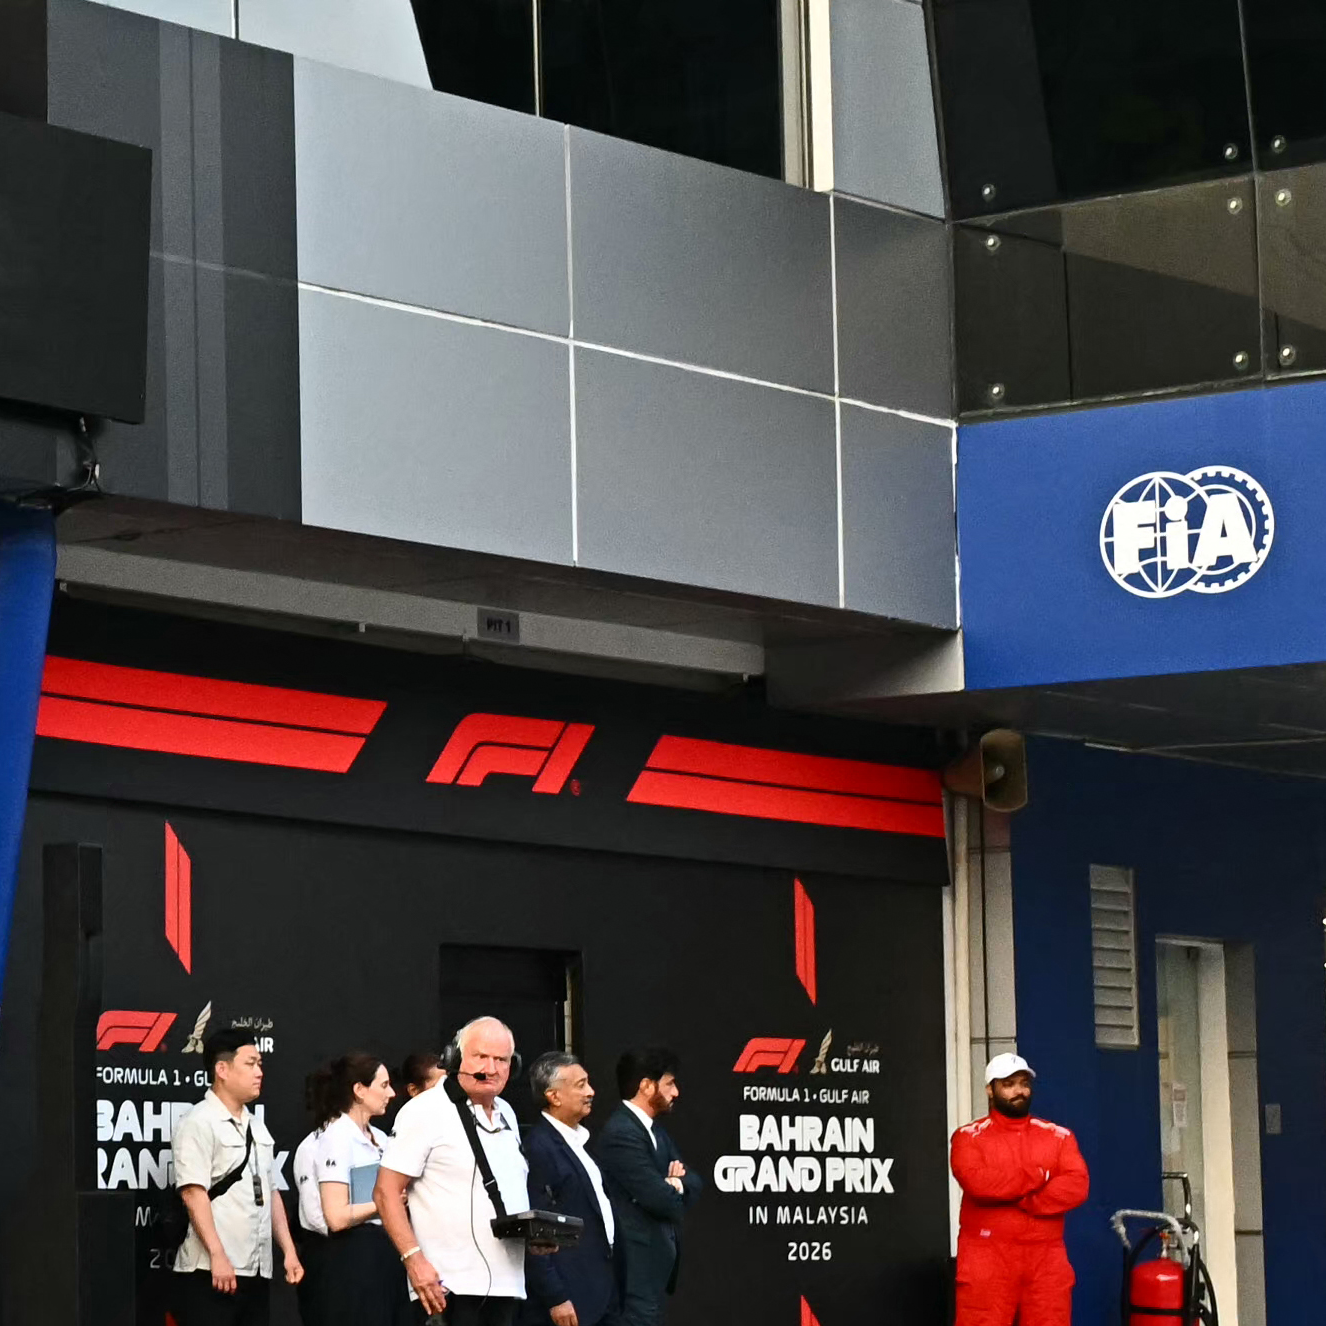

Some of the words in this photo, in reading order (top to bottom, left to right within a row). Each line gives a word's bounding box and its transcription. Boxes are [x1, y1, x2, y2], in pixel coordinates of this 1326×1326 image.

[830, 1057, 860, 1073] GULF
[862, 1058, 880, 1074] AIR
[173, 1069, 181, 1085] 1
[743, 1086, 801, 1102] FORMULA
[803, 1087, 810, 1102] 1
[819, 1088, 848, 1103] GULF
[851, 1089, 869, 1104] AIR
[739, 1114, 874, 1153] BAHRAIN
[713, 1155, 822, 1192] GRAND
[825, 1157, 894, 1193] PRIX
[749, 1206, 768, 1225] IN
[776, 1206, 868, 1225] MALAYSIA
[787, 1241, 832, 1261] 2026
